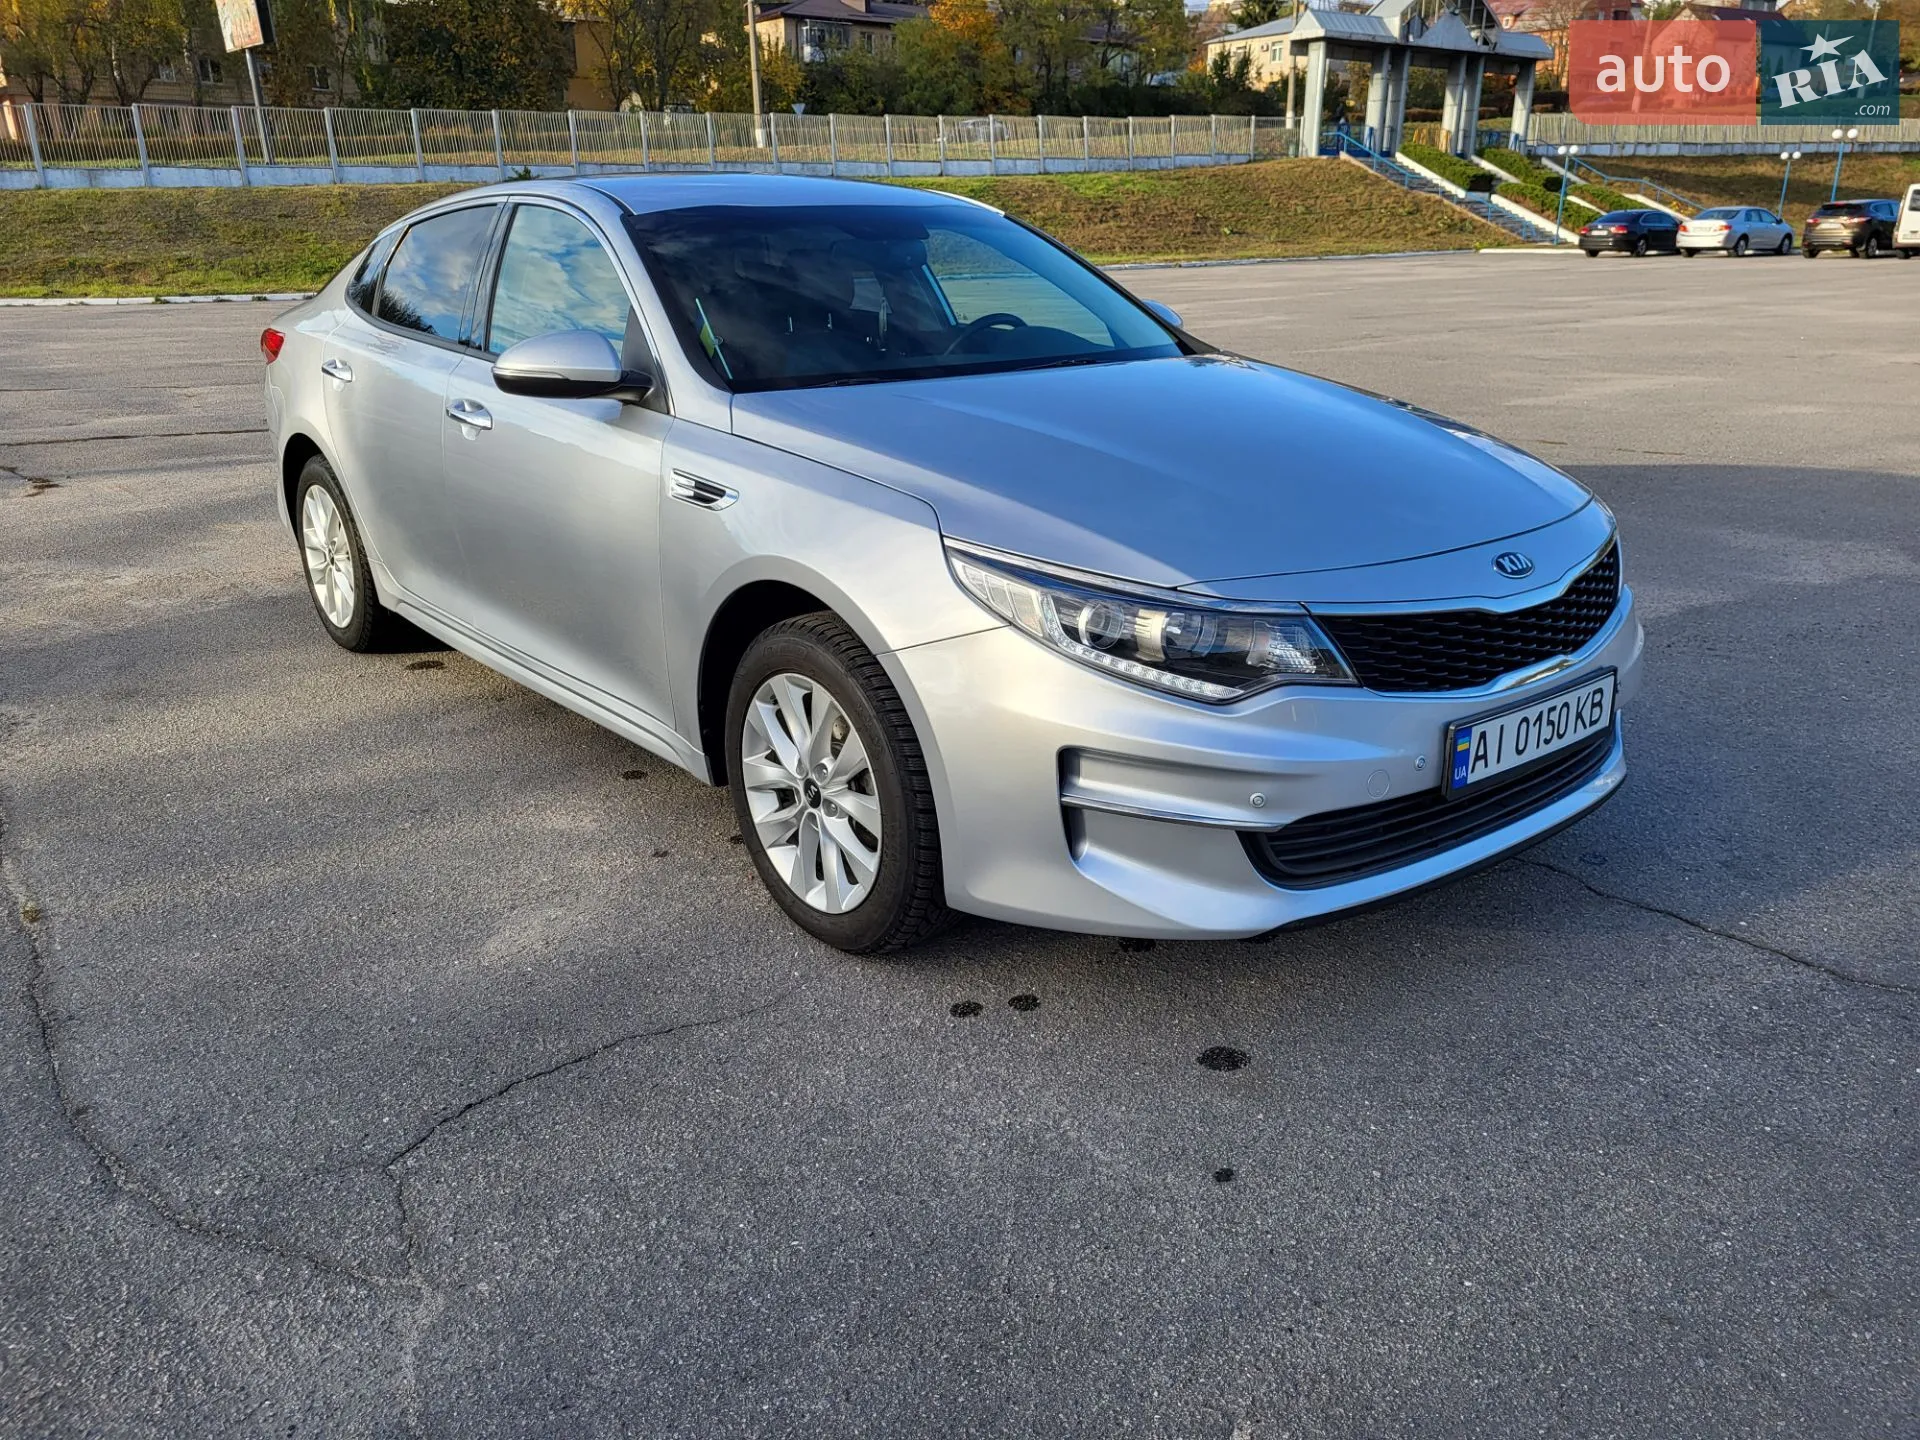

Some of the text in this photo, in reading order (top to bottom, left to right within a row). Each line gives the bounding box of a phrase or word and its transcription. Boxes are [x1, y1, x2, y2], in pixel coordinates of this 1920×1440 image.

[1497, 553, 1532, 573] KIA
[1470, 686, 1604, 775] AI 0150 KB
[1454, 765, 1467, 781] UA
